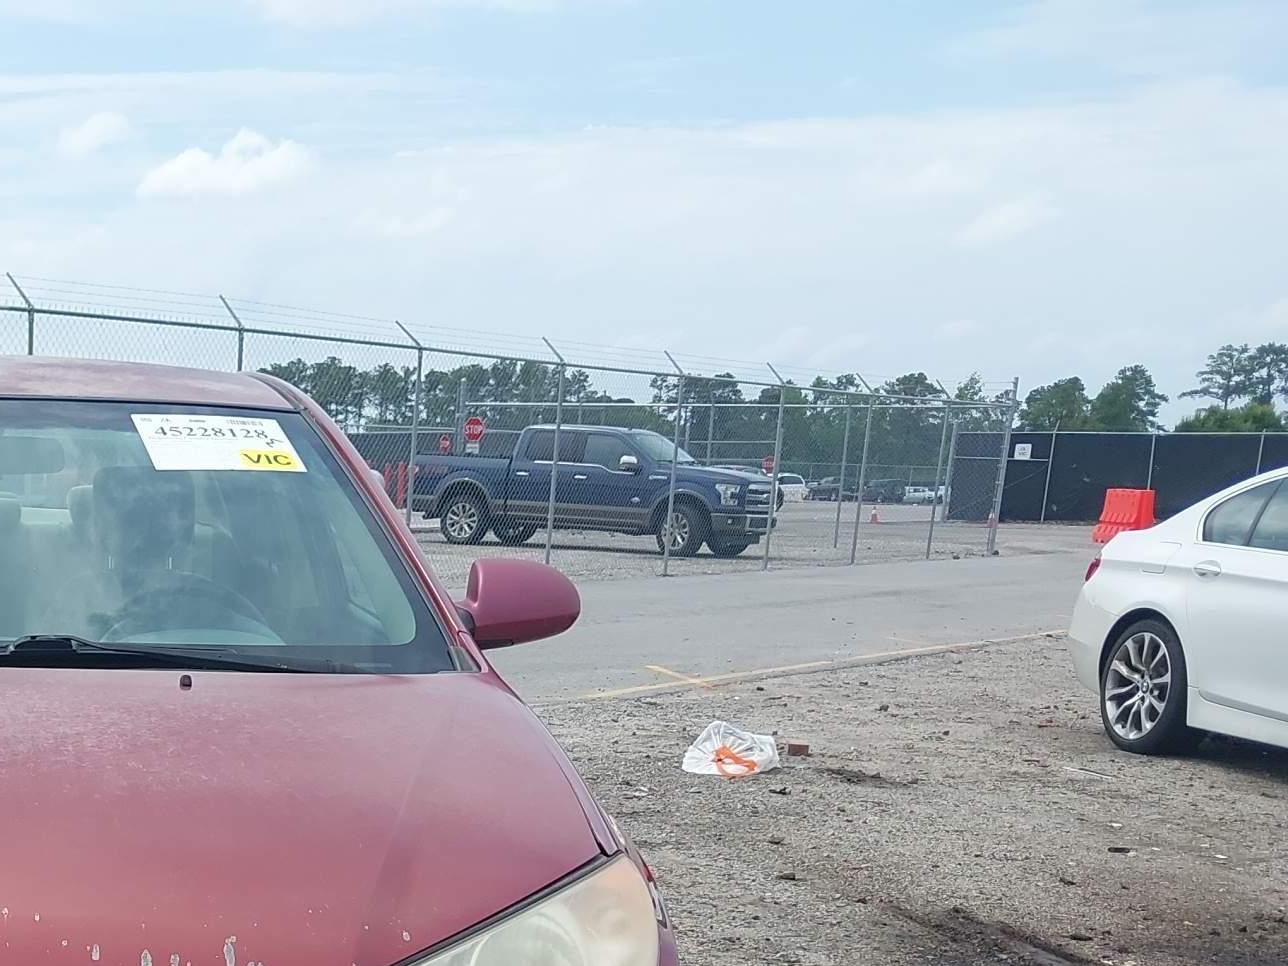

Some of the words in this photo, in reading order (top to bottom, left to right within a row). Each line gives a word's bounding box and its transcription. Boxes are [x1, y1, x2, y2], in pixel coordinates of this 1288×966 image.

[154, 426, 269, 440] 45228128
[465, 424, 483, 434] STOP
[242, 453, 292, 466] VIC
